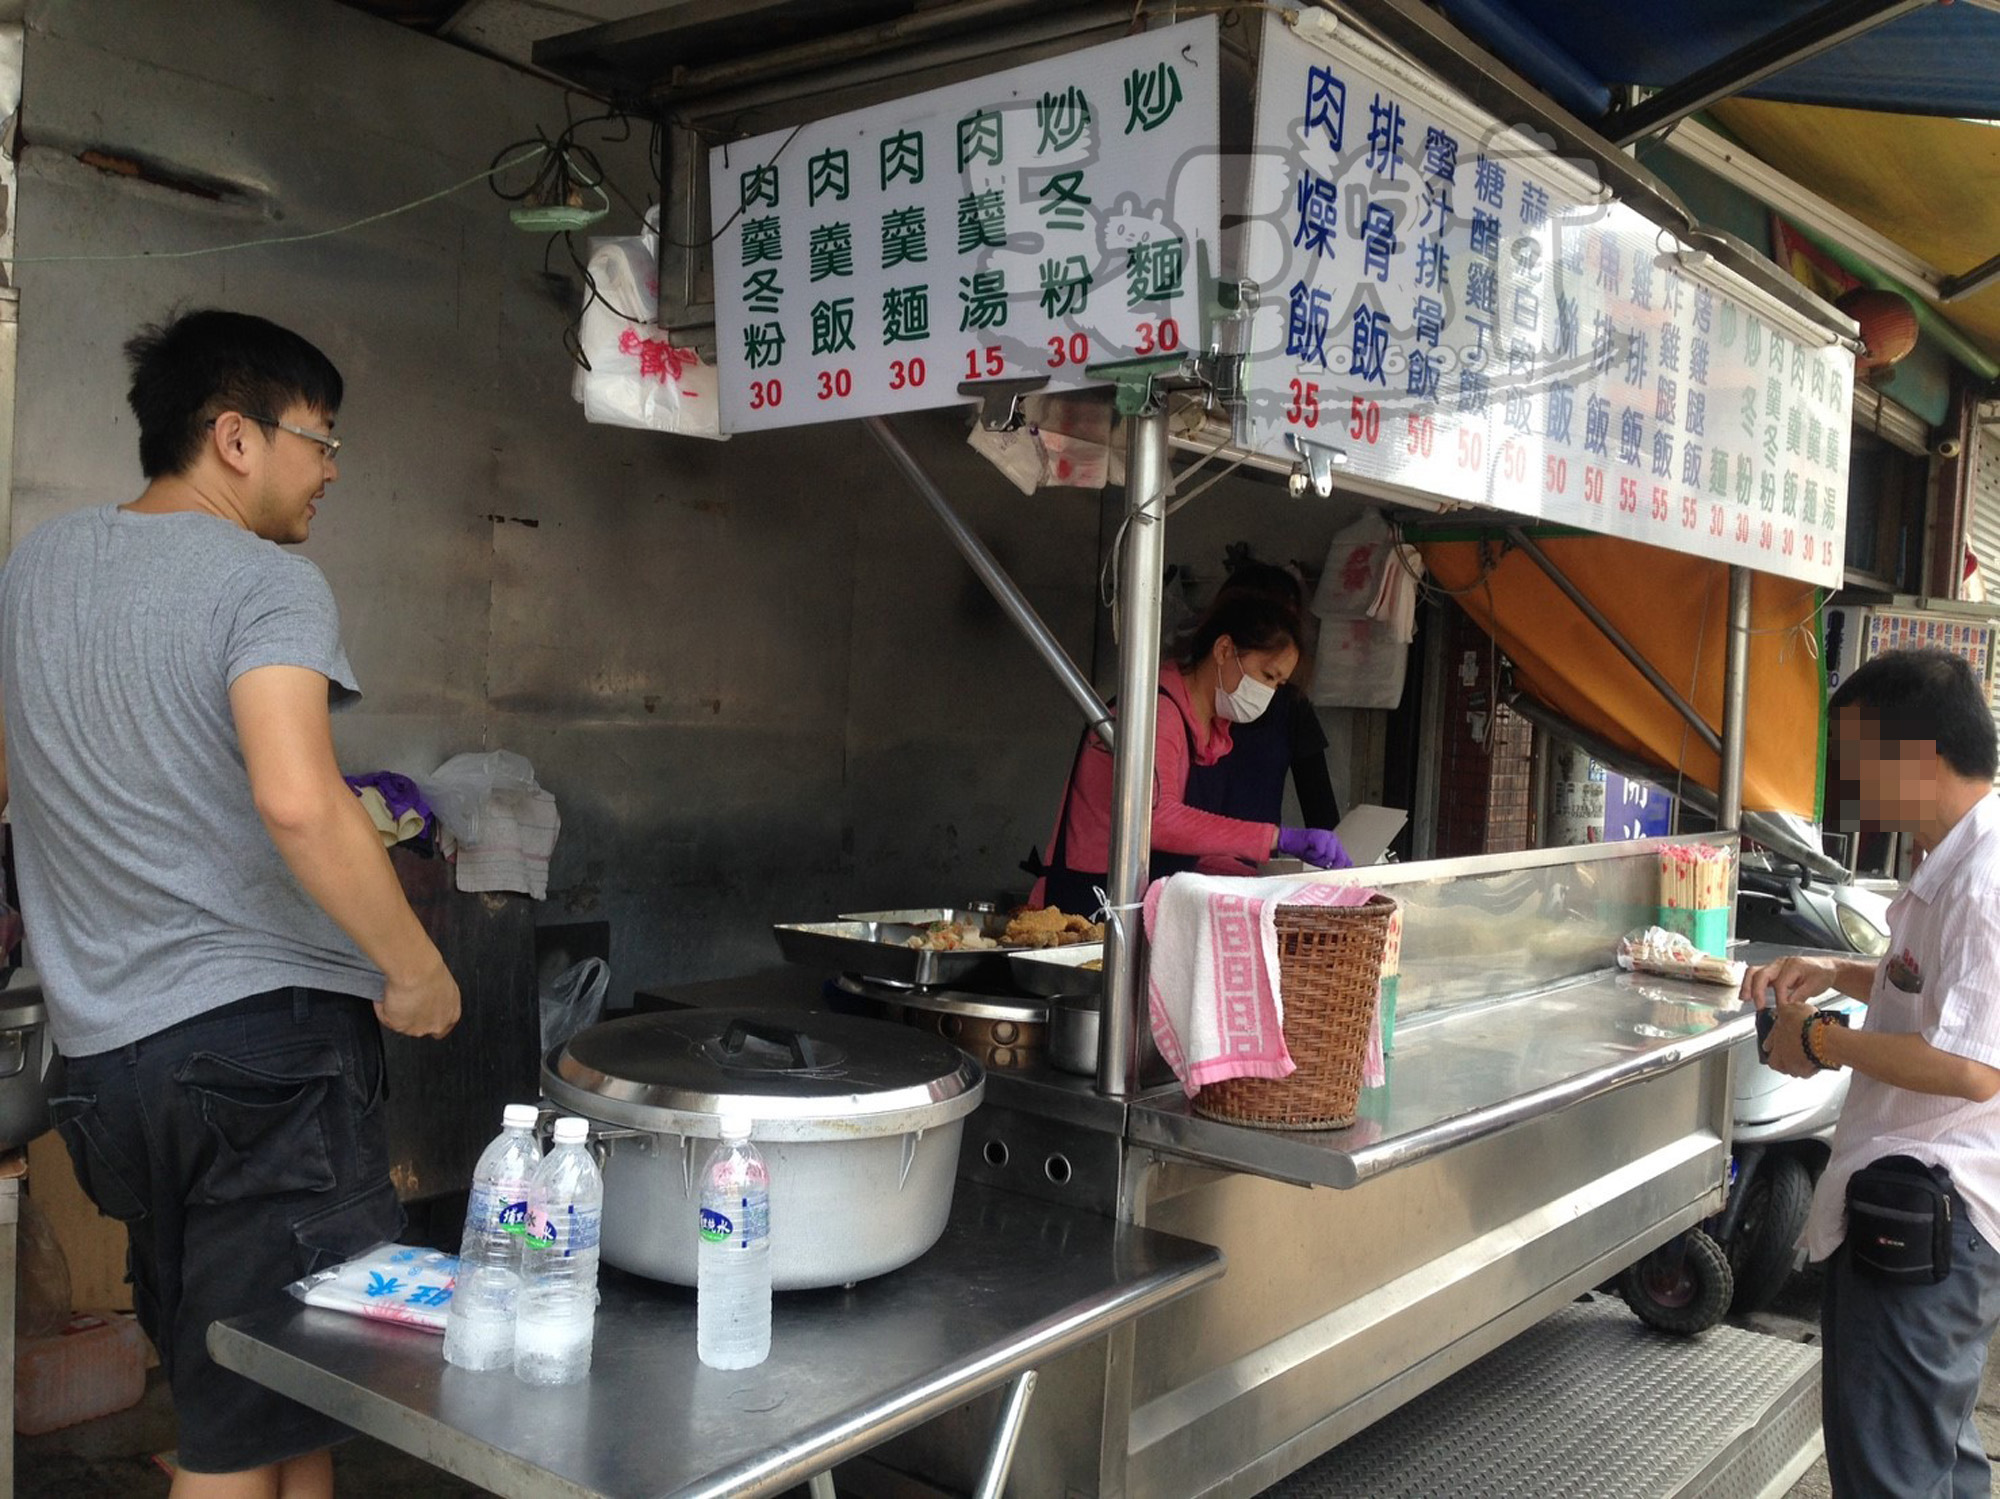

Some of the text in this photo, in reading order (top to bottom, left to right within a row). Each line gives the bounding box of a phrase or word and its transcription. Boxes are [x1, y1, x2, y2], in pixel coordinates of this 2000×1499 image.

[957, 109, 1008, 380] 肉羹湯 15
[1036, 86, 1093, 368] 炒冬粉 30
[880, 129, 930, 390] 肉羹麵 30
[1285, 65, 1347, 429] 肉燥飯 35
[741, 164, 785, 409] 肉羹冬粉 30
[808, 148, 855, 400] 肉羹飯 30
[1349, 93, 1406, 445] 排骨飯 50
[1406, 125, 1459, 458] 蜜汁排骨飯 50
[1457, 153, 1507, 472] 糖醋雞丁飯 50
[1135, 319, 1180, 355] 30
[1504, 443, 1526, 484] 50
[1546, 454, 1567, 494] 50
[1584, 466, 1604, 503] 50
[1619, 477, 1637, 514] 55
[1651, 487, 1668, 521] 55
[1682, 497, 1698, 530] 55
[1710, 504, 1724, 537] 30
[1736, 512, 1749, 543] 30
[1760, 520, 1772, 550] 30
[1782, 527, 1794, 556] 30
[1804, 534, 1815, 562] 30
[1822, 540, 1833, 566] 15
